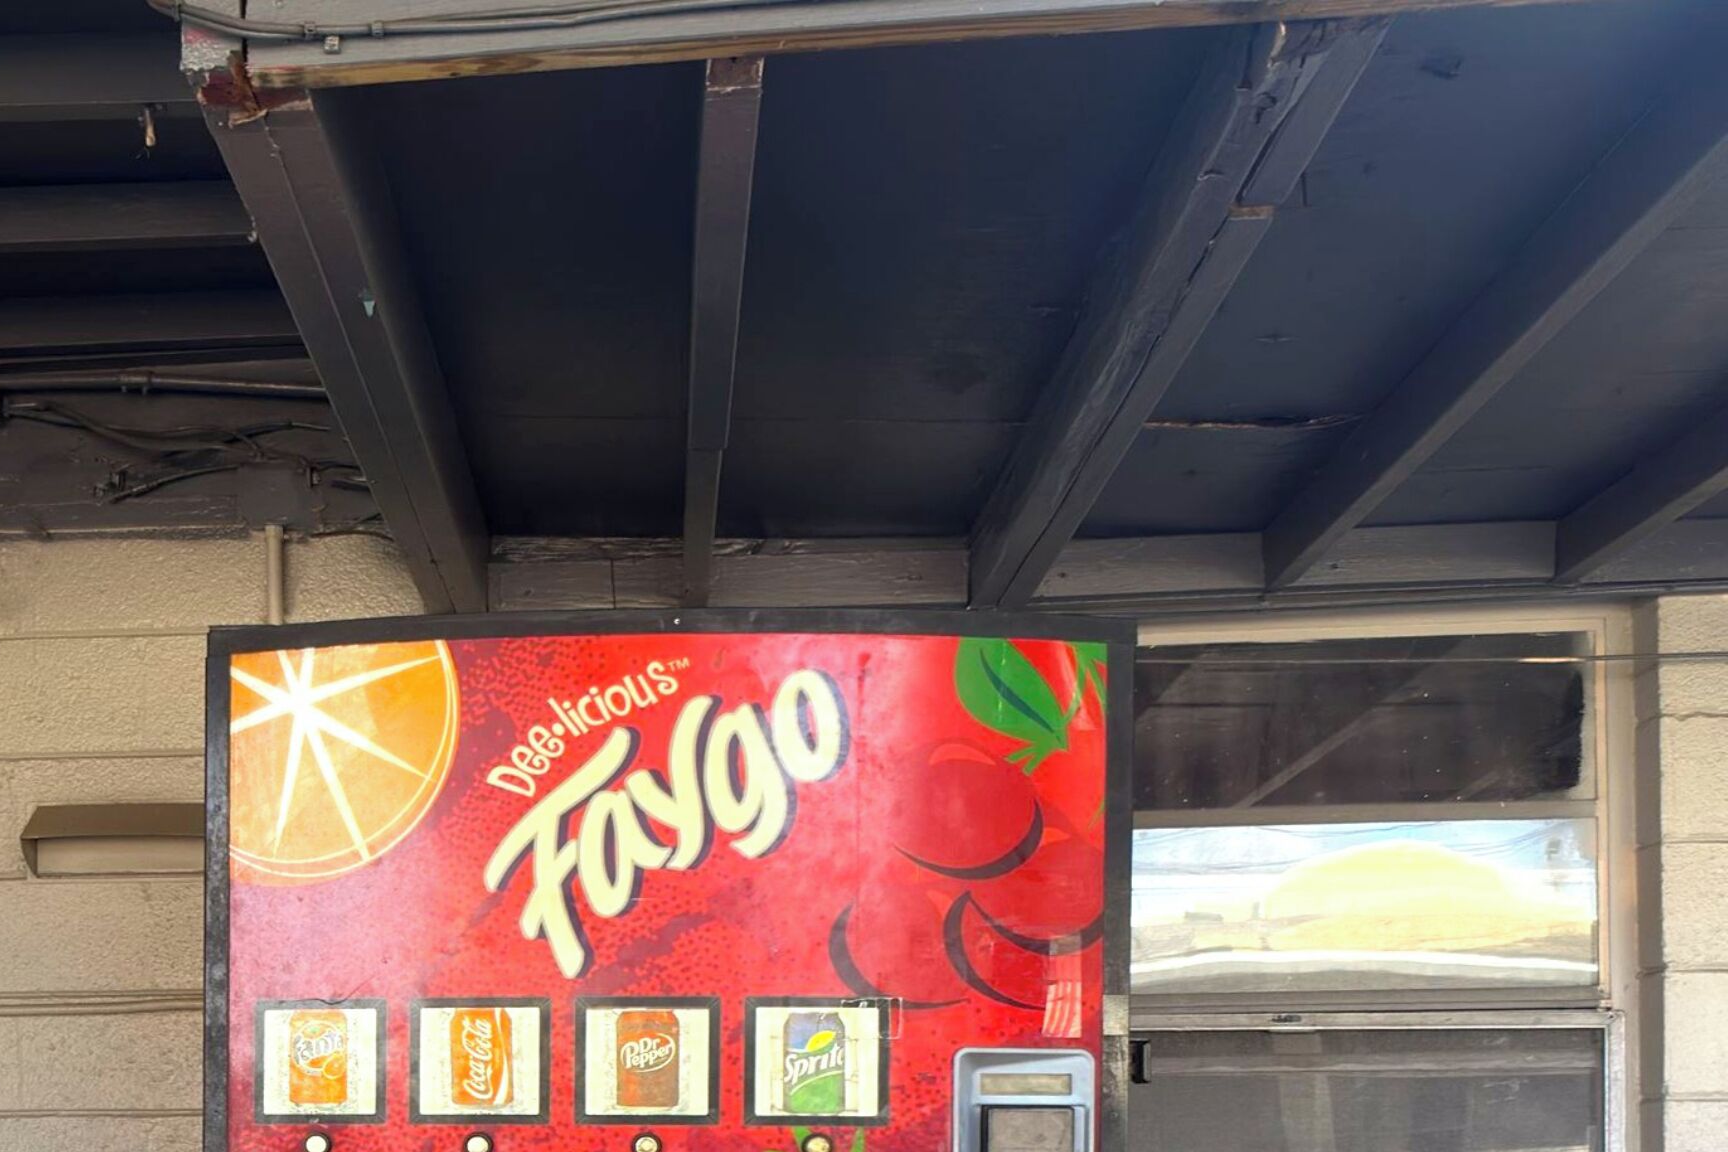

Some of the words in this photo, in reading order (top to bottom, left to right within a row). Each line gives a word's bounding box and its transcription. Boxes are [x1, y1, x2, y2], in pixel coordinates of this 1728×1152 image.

[483, 669, 845, 980] Faygo
[621, 1041, 673, 1069] Pepper
[639, 1037, 660, 1053] Dr
